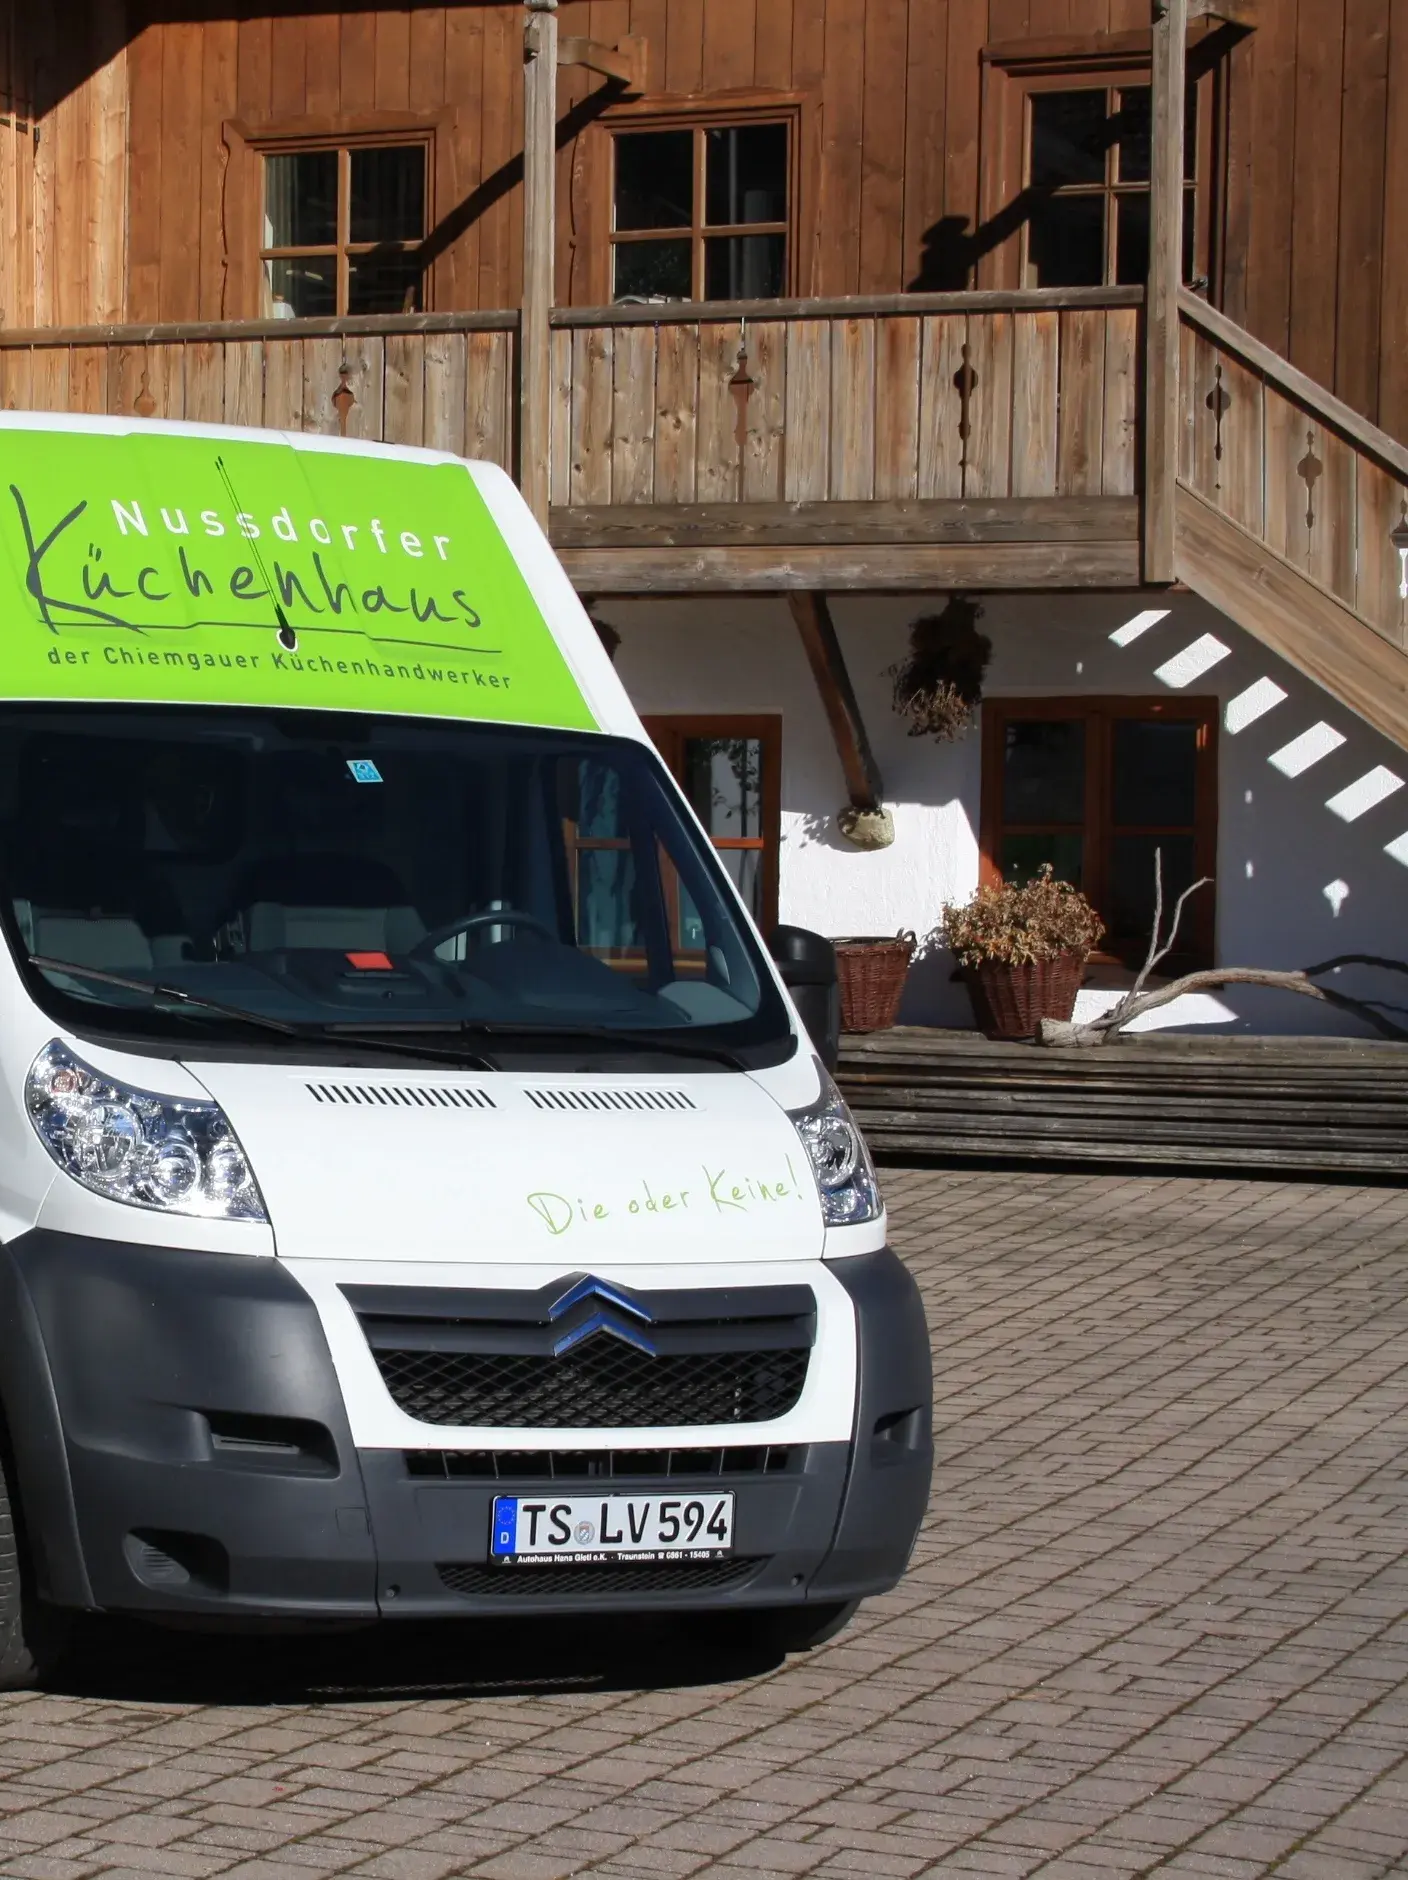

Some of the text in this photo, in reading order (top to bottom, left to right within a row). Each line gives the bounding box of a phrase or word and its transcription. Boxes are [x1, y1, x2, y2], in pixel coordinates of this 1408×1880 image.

[110, 498, 452, 561] Nussdorfer
[8, 484, 483, 636] Küchenhaus
[47, 647, 512, 690] der Chiemgauer Küchenhandwerker
[526, 1153, 803, 1235] Die oder Keine!
[500, 1532, 510, 1544] D
[522, 1504, 572, 1546] TS
[517, 1554, 553, 1564] Autohaus
[617, 1551, 656, 1561] Traunstein
